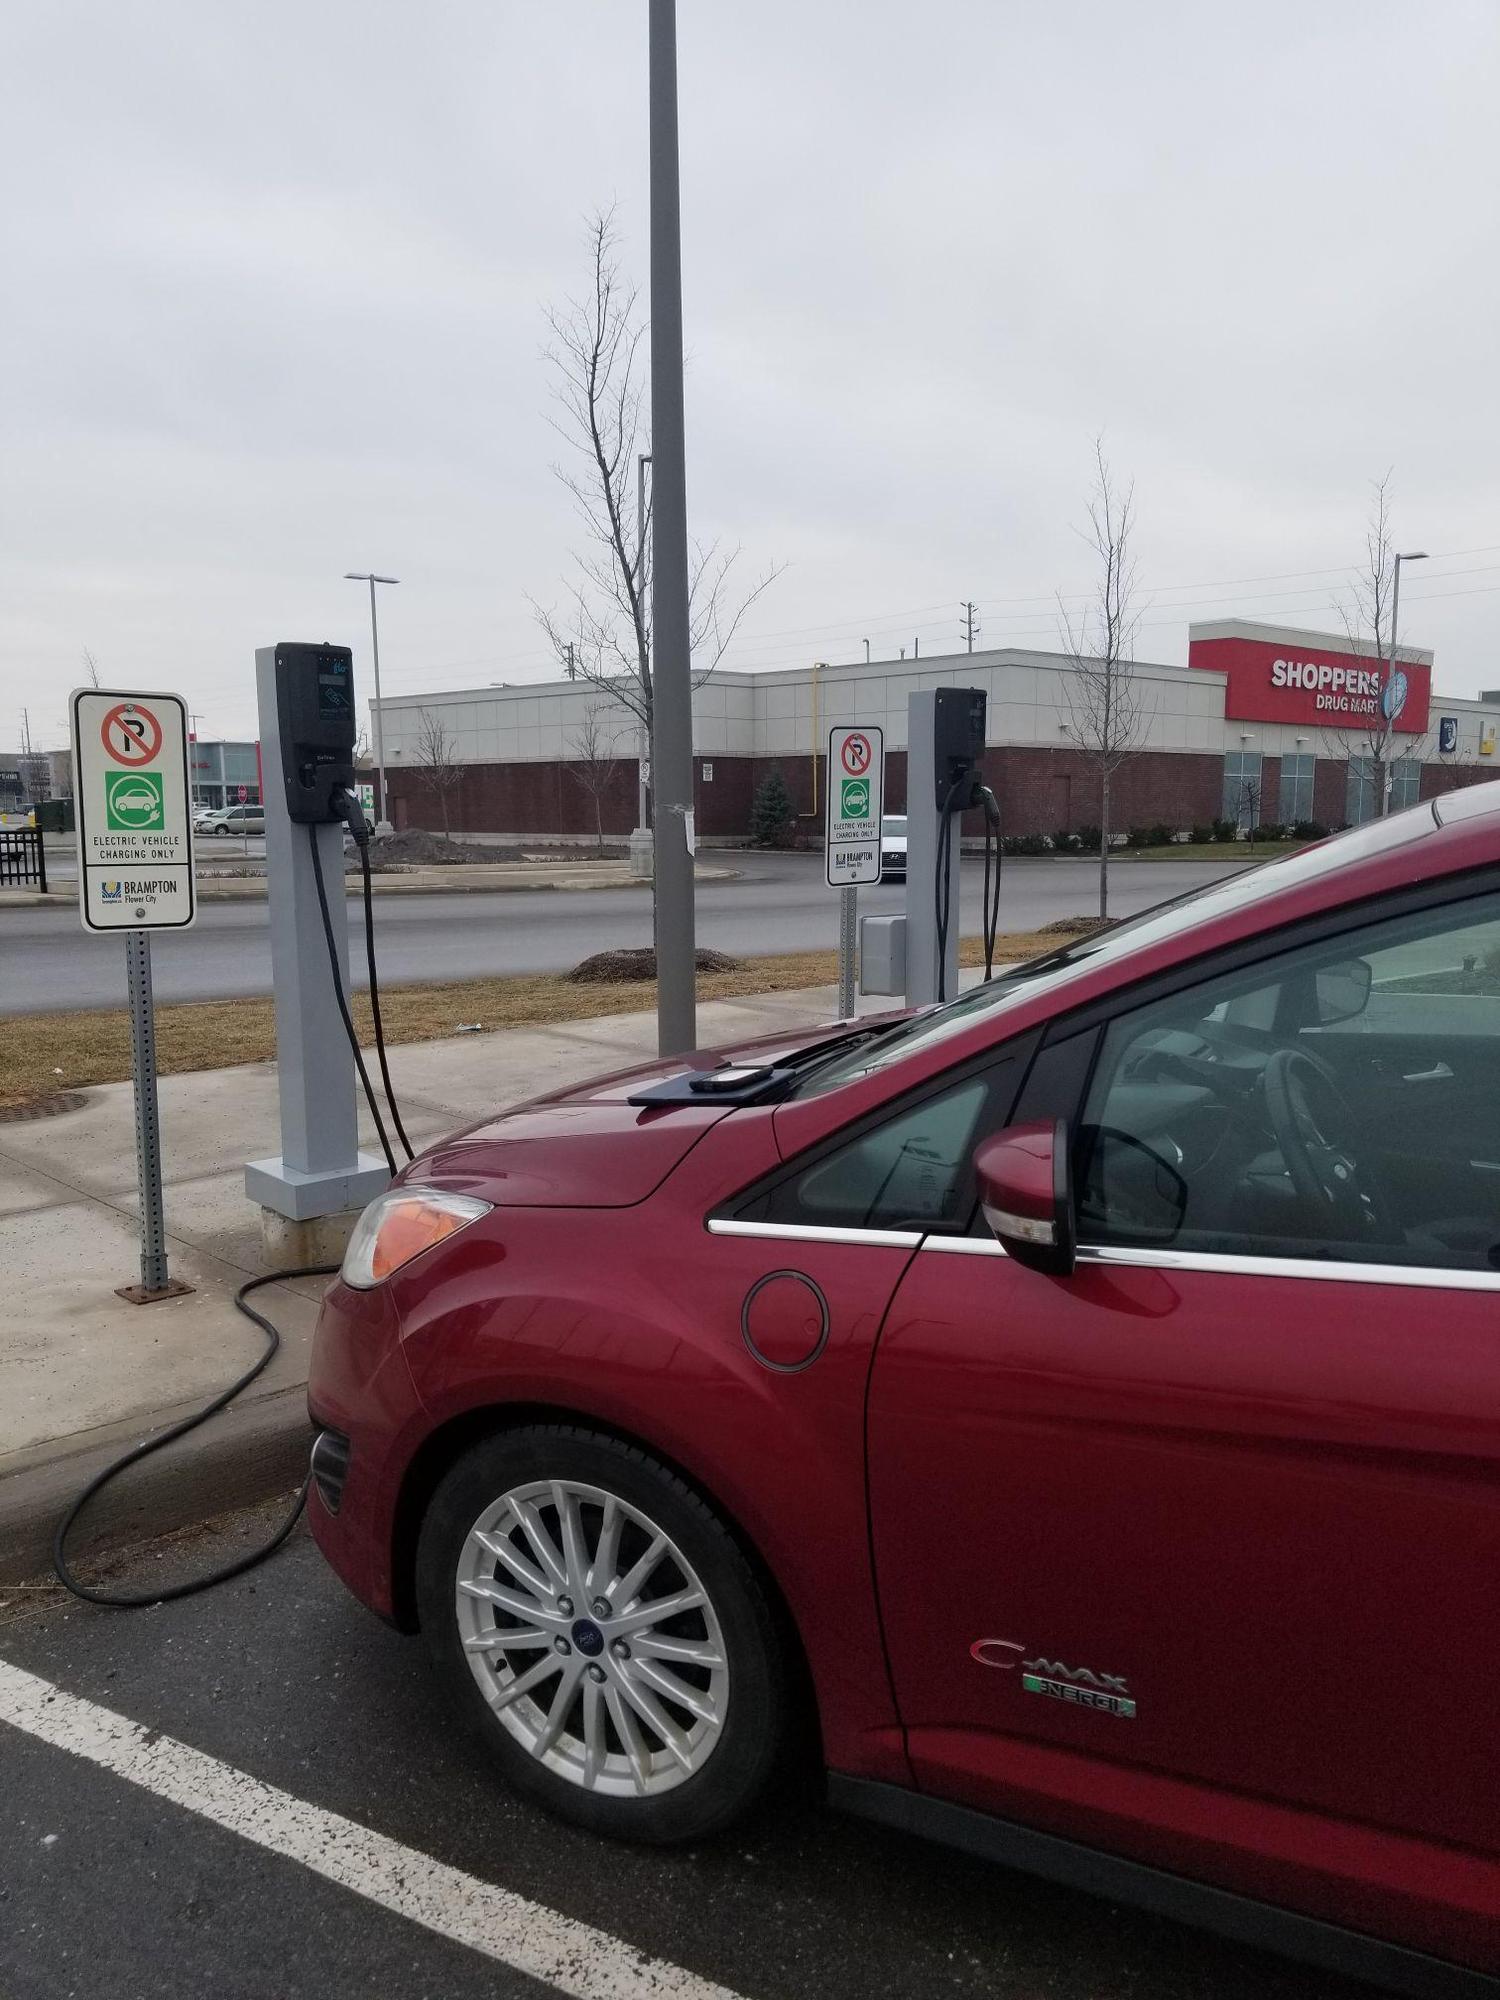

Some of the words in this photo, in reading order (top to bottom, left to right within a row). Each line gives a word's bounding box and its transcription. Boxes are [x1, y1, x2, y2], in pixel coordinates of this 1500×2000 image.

[1272, 659, 1383, 697] SHOPPERS
[1316, 694, 1348, 711] DRUG
[93, 836, 137, 846] ELECTRIC
[142, 836, 180, 845] VEHICLE
[99, 849, 146, 859] CHARGING
[151, 849, 175, 859] ONLY
[124, 880, 177, 894] BRAMPTON
[125, 895, 144, 903] Flower
[145, 894, 157, 904] City
